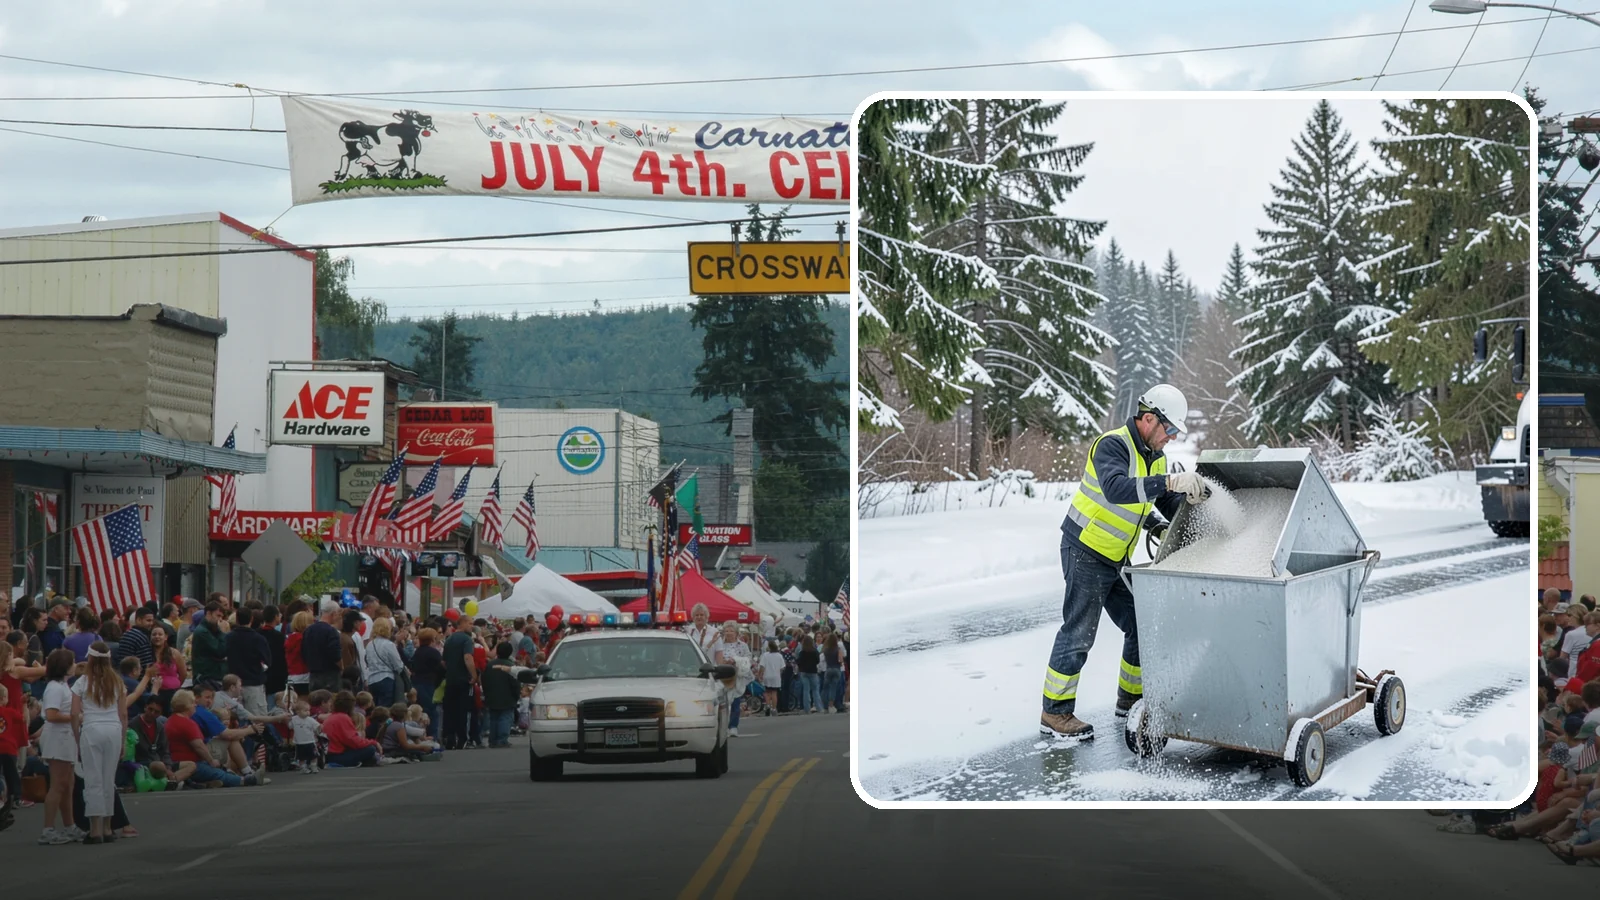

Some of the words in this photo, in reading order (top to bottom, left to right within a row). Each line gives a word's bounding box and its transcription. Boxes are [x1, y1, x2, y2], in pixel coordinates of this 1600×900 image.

[481, 141, 605, 193] JULY
[632, 150, 746, 198] 4th.
[697, 254, 850, 280] CROSSWA
[283, 380, 373, 420] ACE
[406, 409, 453, 422] CEDAR
[283, 421, 371, 436] Hardware
[95, 485, 124, 495] Vincent
[126, 486, 135, 494] de
[137, 486, 155, 495] Paul
[688, 526, 741, 536] CRNATION
[699, 535, 730, 544] GLASS
